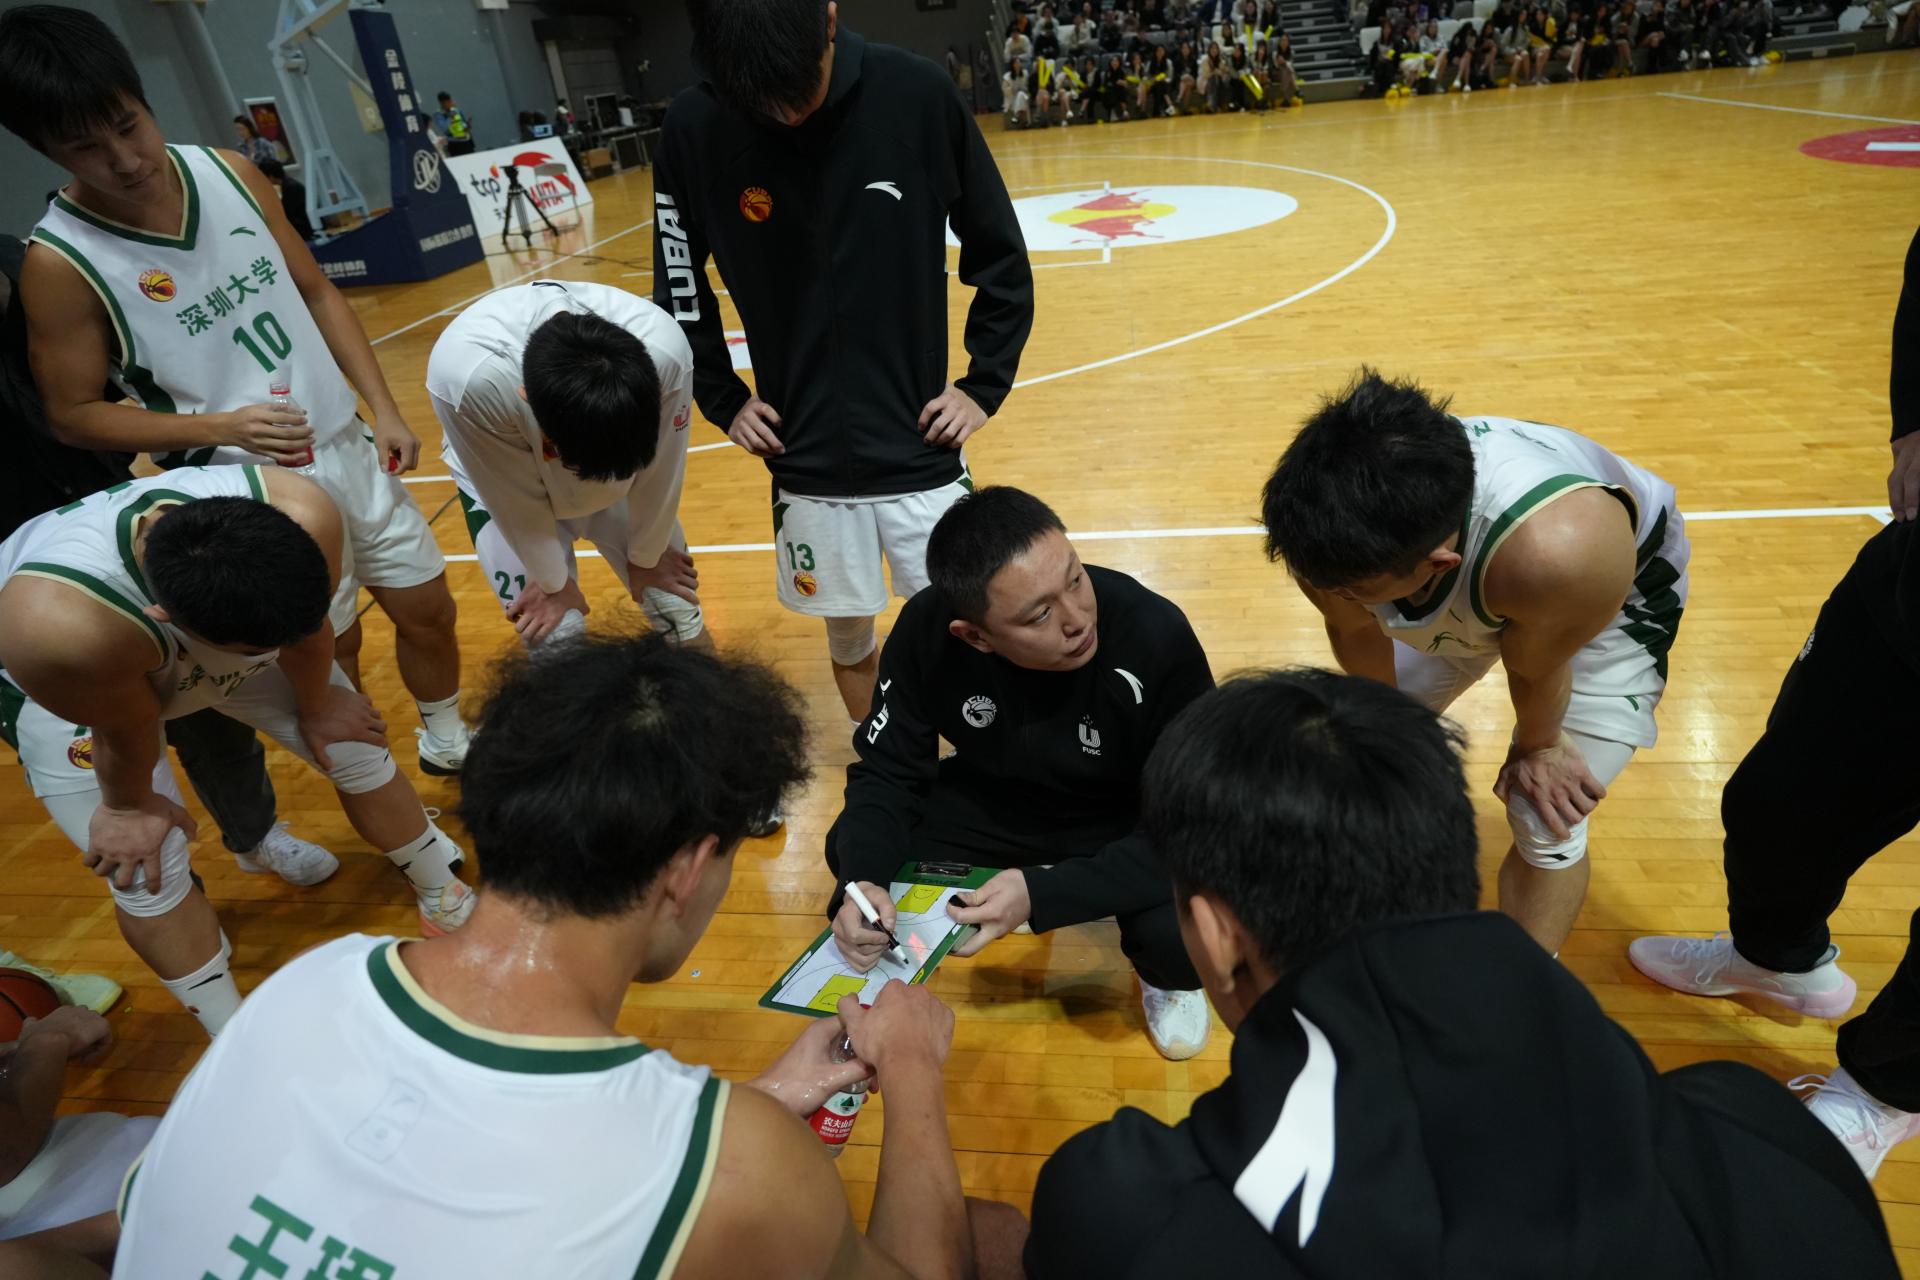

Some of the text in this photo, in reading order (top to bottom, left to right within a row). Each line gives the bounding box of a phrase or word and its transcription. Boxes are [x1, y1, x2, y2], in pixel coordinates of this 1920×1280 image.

[655, 192, 701, 321] CUBAL
[176, 256, 278, 337] 深圳大学
[232, 311, 292, 373] 10
[786, 541, 816, 571] 13
[494, 570, 526, 600] 21
[1082, 746, 1102, 756] FUSC
